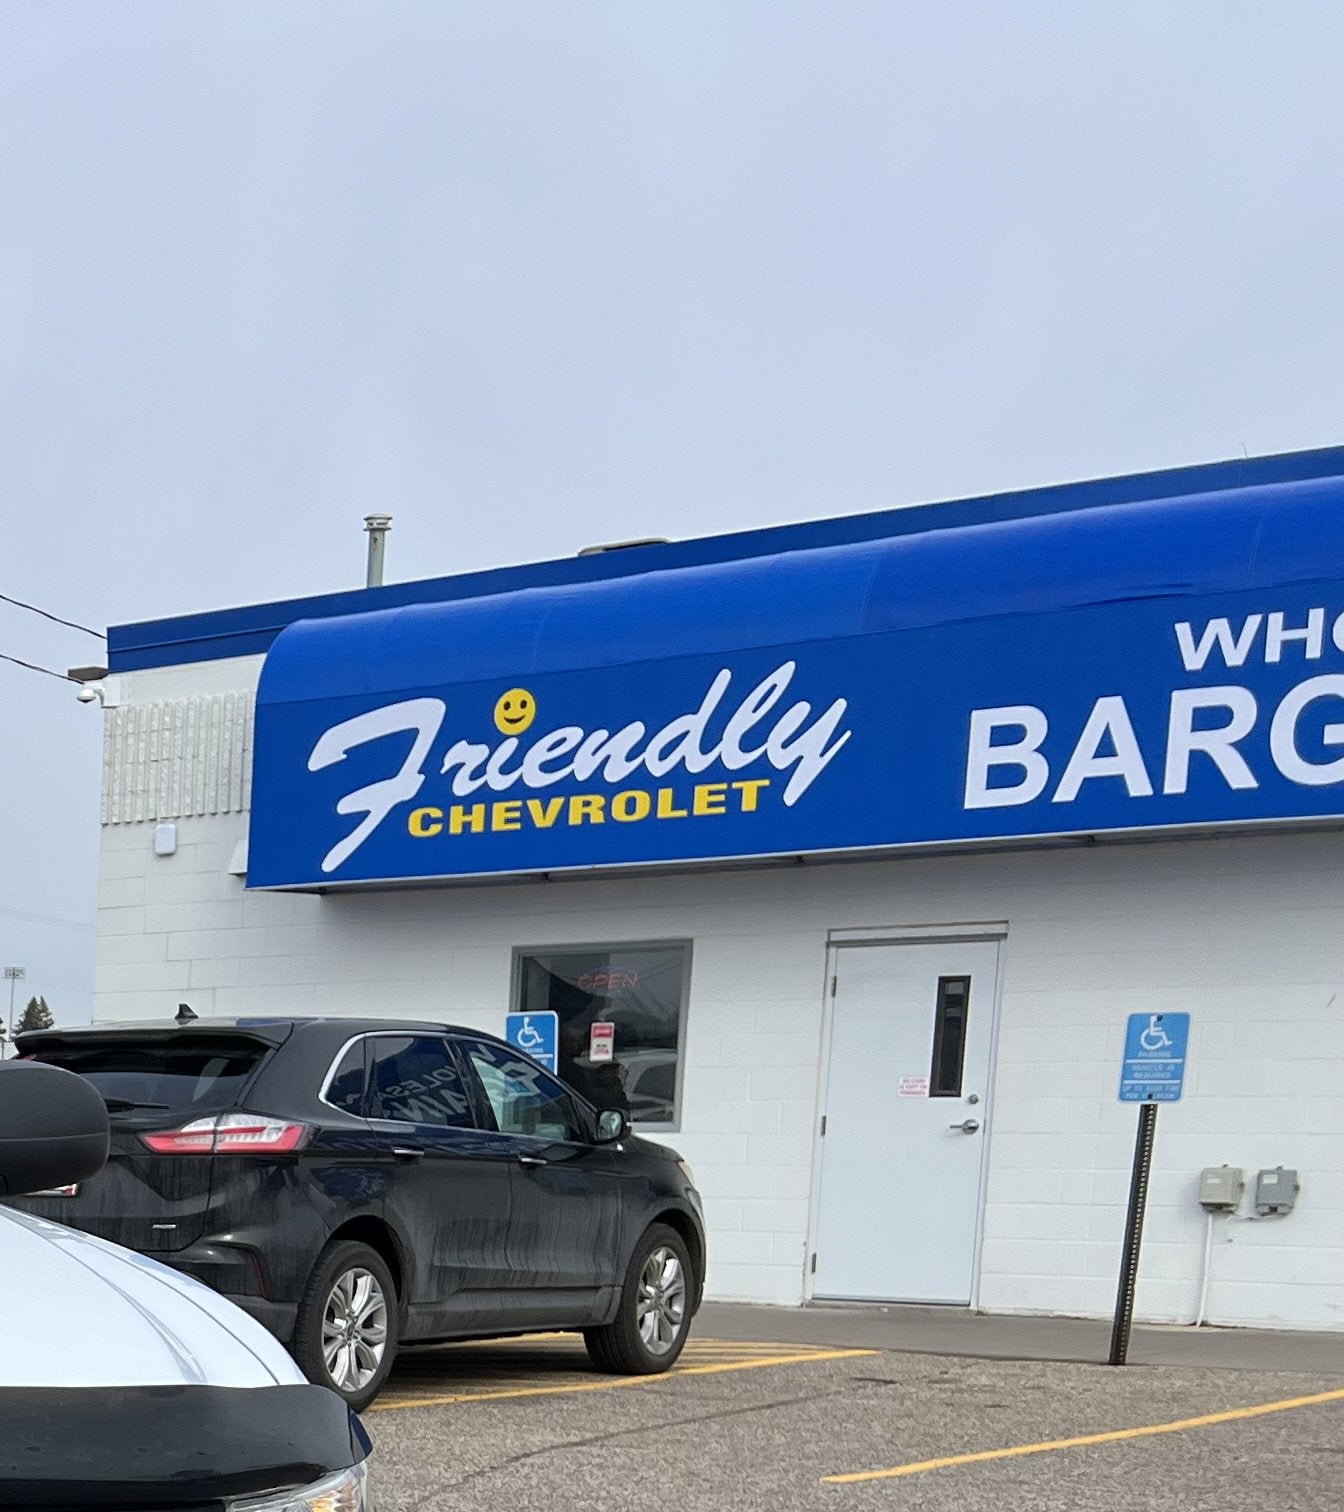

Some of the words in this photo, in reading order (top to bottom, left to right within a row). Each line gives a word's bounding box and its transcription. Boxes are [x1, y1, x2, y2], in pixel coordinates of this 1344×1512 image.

[1174, 606, 1344, 672] WH
[307, 660, 852, 873] Friendly
[963, 672, 1344, 810] BARG
[407, 778, 771, 837] CHEVROLET
[577, 971, 639, 990] OPEN
